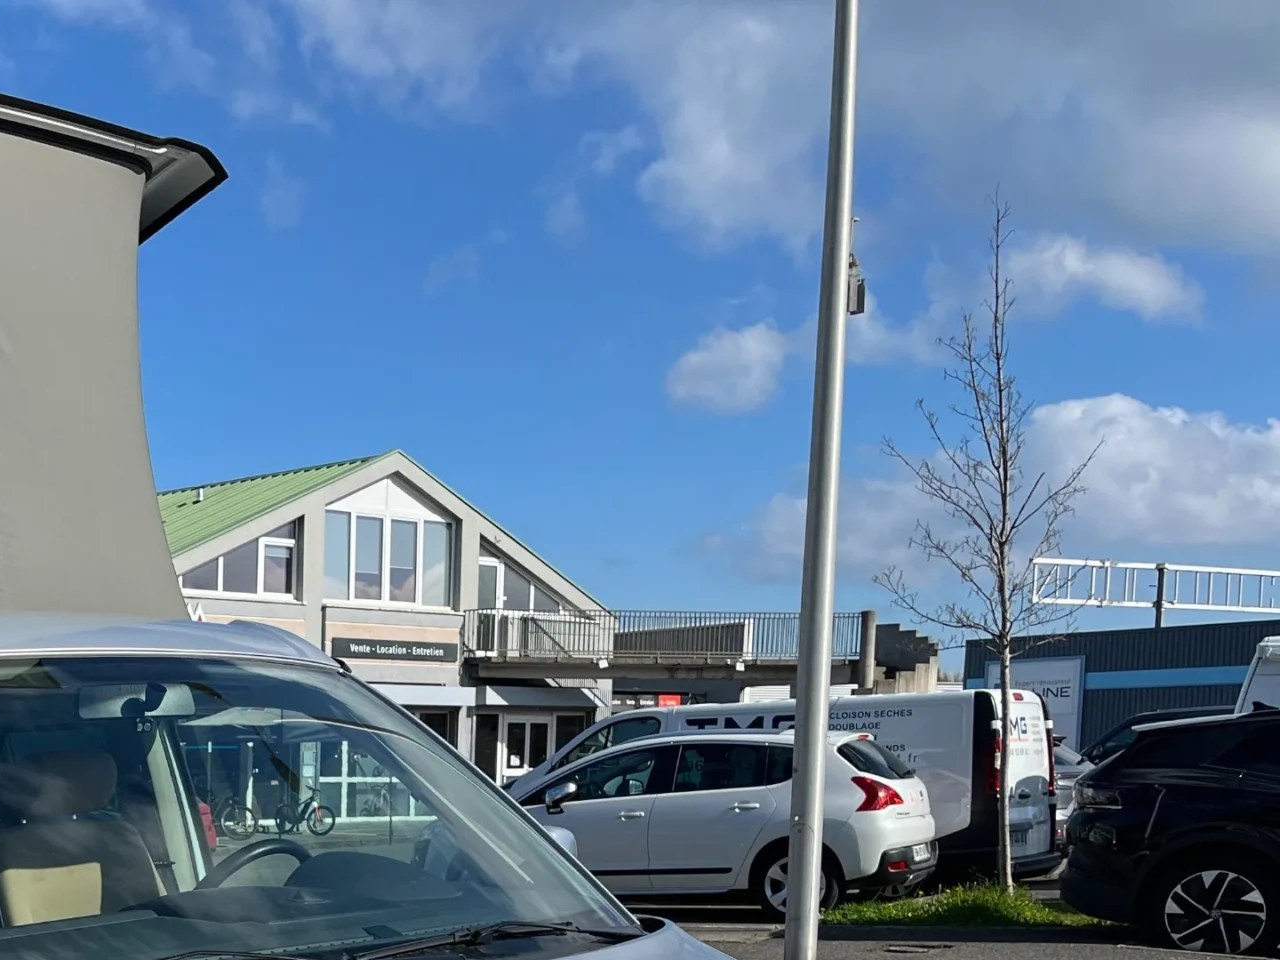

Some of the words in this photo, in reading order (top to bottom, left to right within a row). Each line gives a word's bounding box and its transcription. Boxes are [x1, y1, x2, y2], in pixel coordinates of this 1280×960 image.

[350, 644, 370, 653] Vente
[376, 645, 407, 655] Location
[412, 646, 444, 657] Entretien
[829, 711, 871, 720] CLOISON
[874, 709, 913, 718] SECHES
[829, 722, 881, 731] DOUBLAGE
